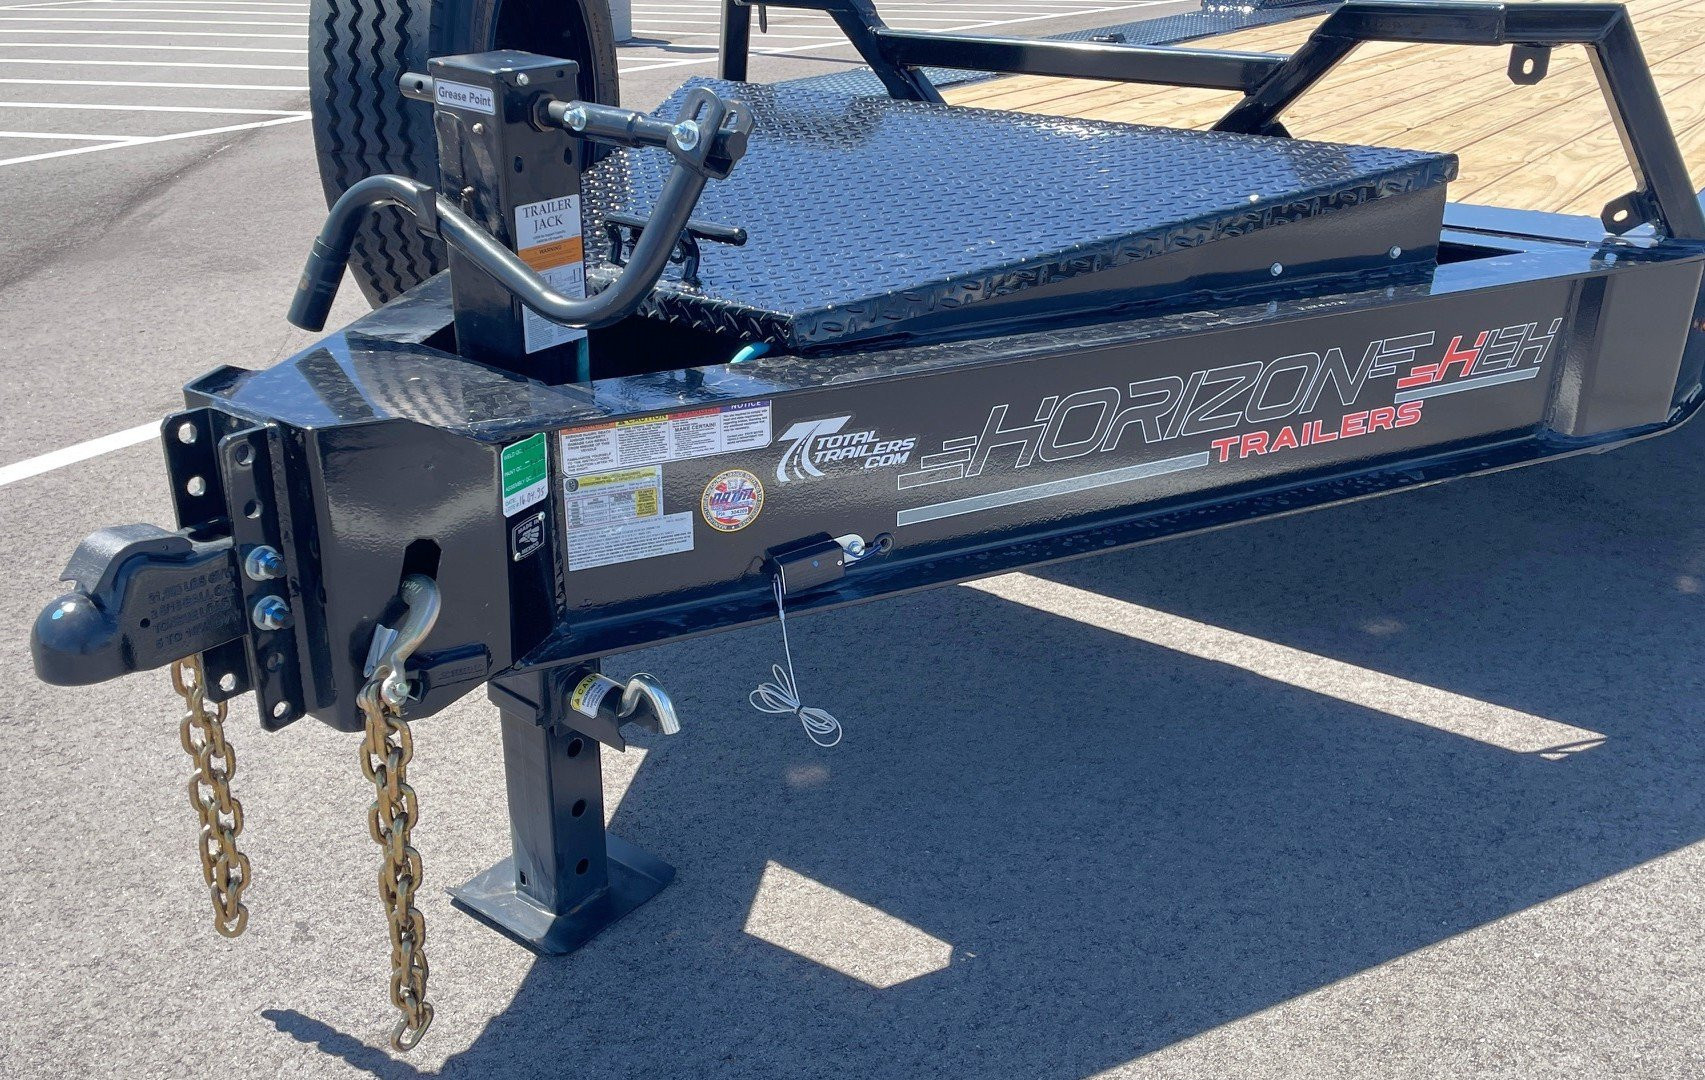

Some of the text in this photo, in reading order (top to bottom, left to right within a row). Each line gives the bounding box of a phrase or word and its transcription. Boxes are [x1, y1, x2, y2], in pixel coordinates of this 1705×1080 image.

[438, 85, 492, 107] Grease Point
[522, 198, 572, 218] TRAILER
[533, 214, 563, 234] JACK
[963, 340, 1382, 478] HORIZON
[674, 425, 691, 433] MAKE
[1211, 400, 1424, 463] TRAILERS
[817, 430, 880, 450] TOTAL
[815, 437, 917, 464] TRAILERS
[859, 451, 910, 470] .COM
[517, 521, 533, 535] MADE
[521, 540, 540, 555] MEXICO
